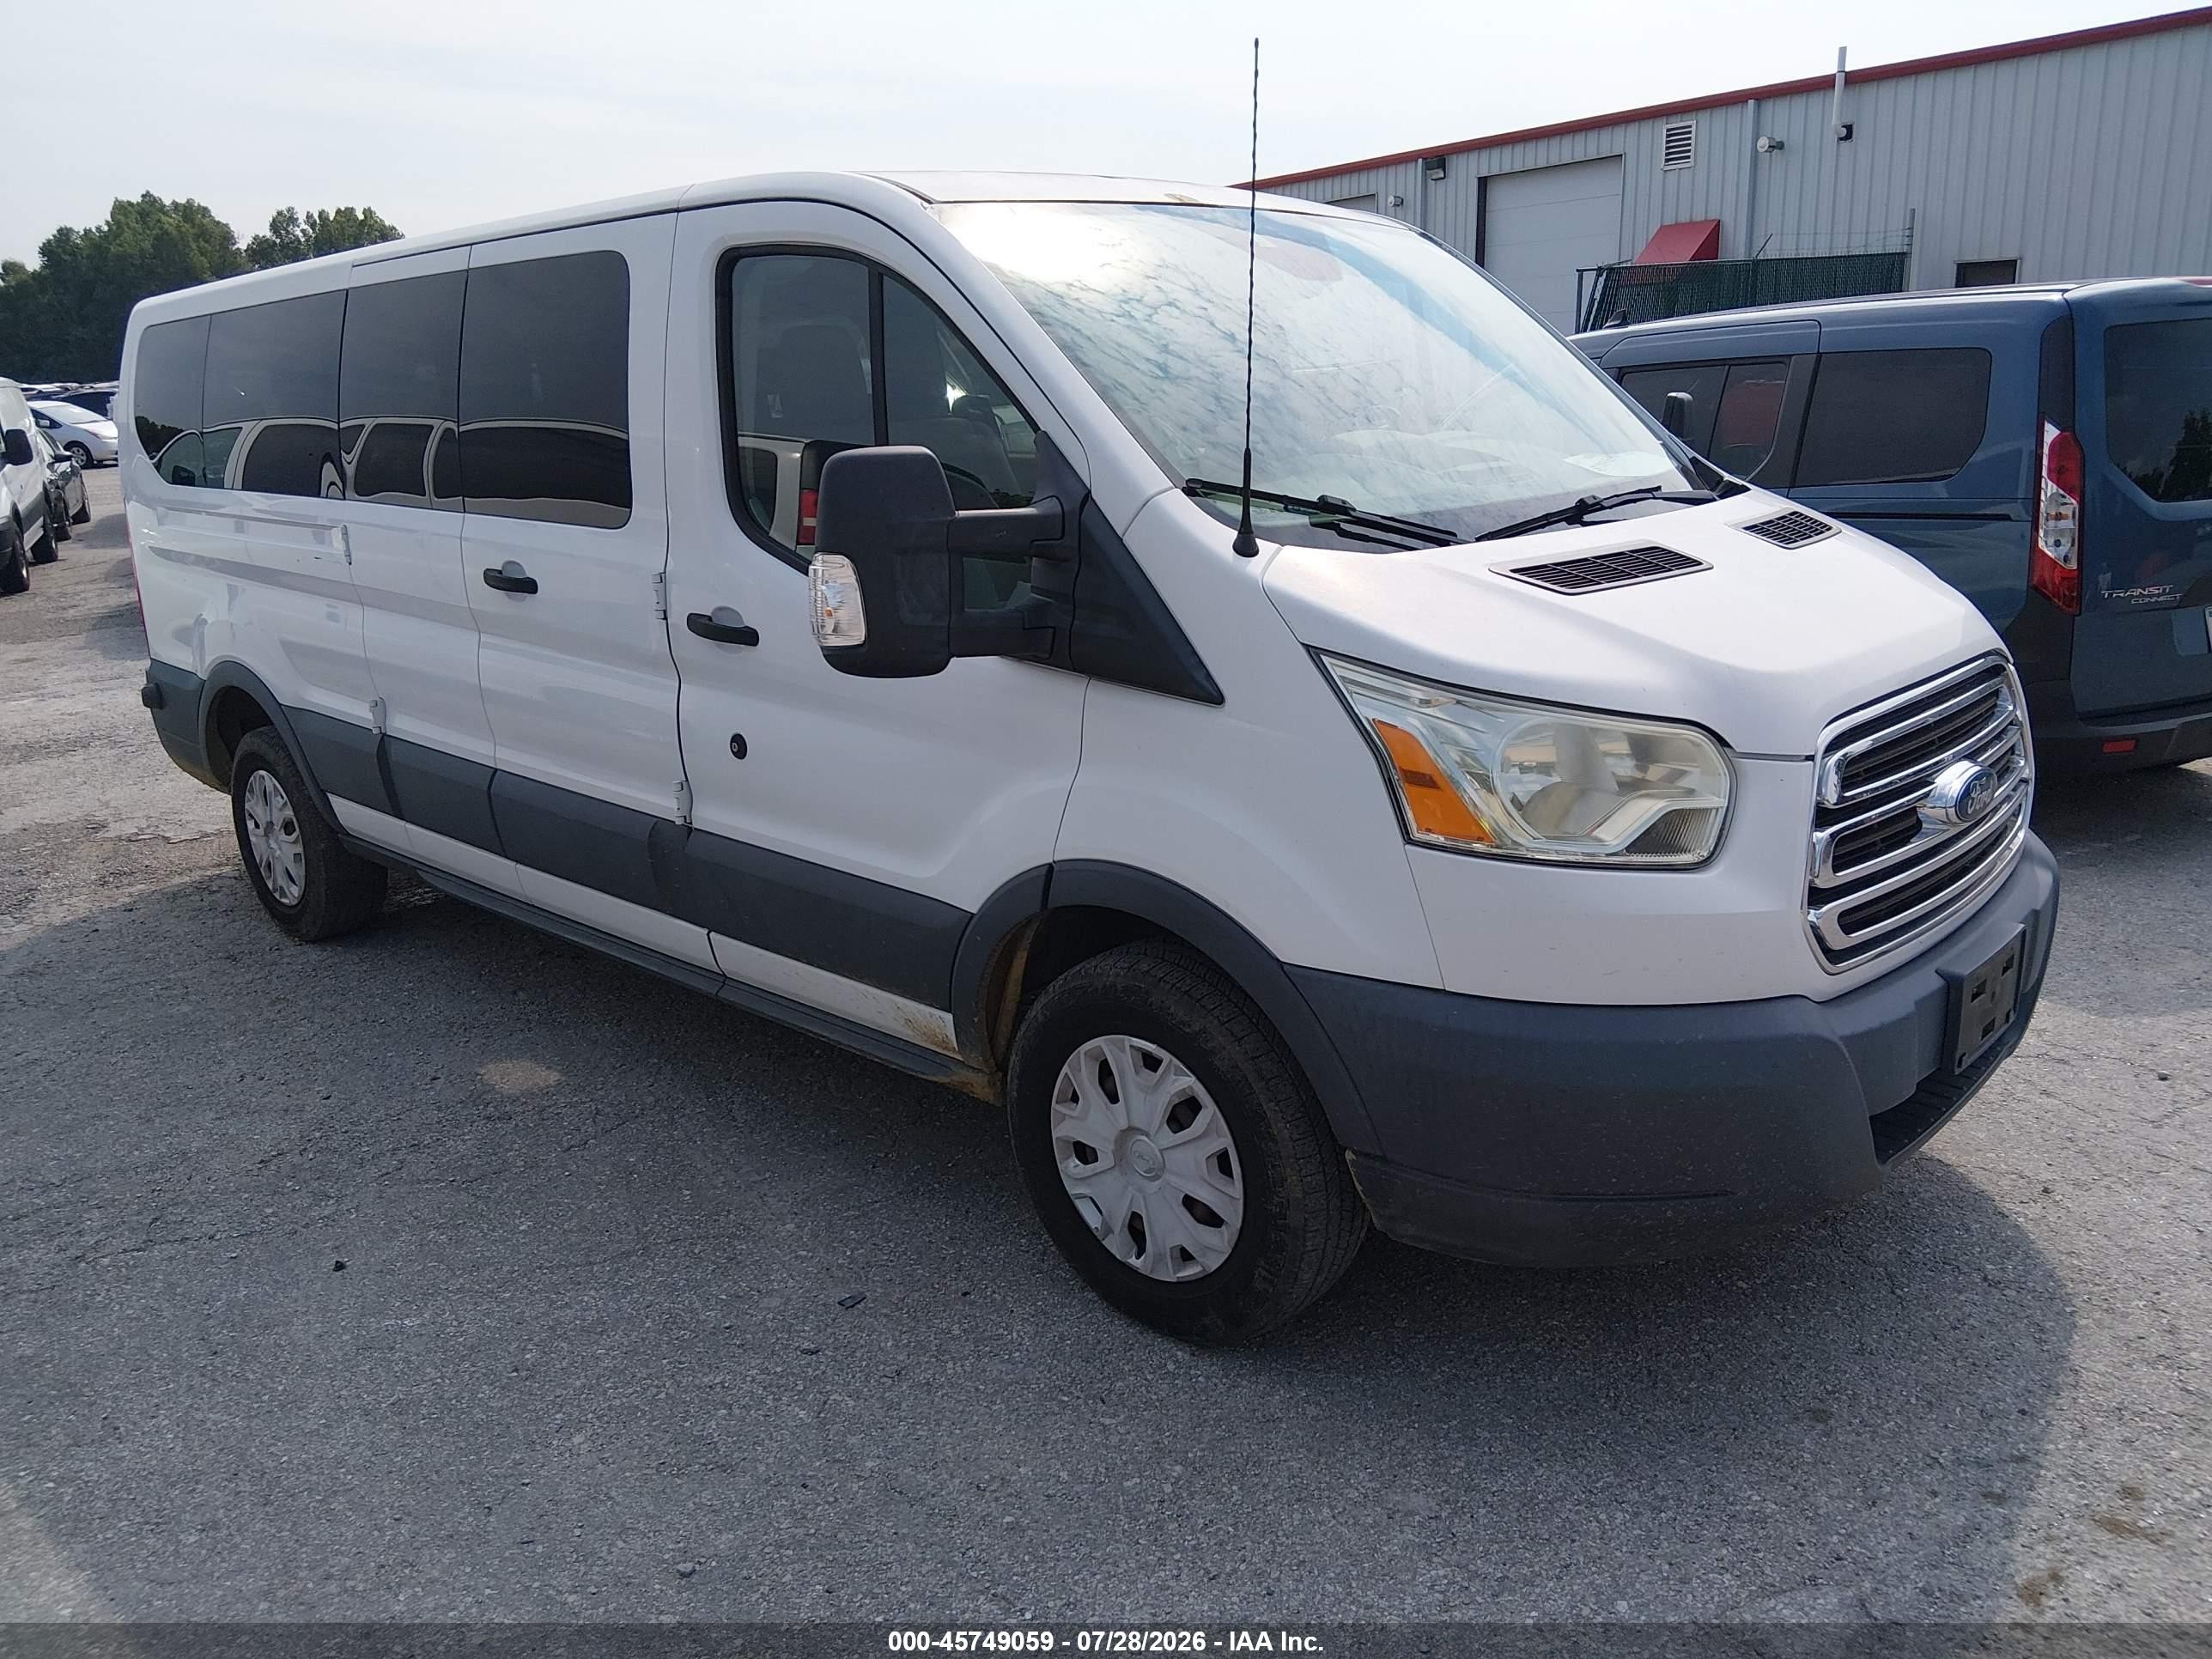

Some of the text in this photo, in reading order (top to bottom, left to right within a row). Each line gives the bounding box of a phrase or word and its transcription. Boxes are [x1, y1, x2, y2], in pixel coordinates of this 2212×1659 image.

[2101, 585, 2173, 599] TRANSIT
[2131, 593, 2183, 604] CONNECT
[1967, 776, 1993, 815] Ford
